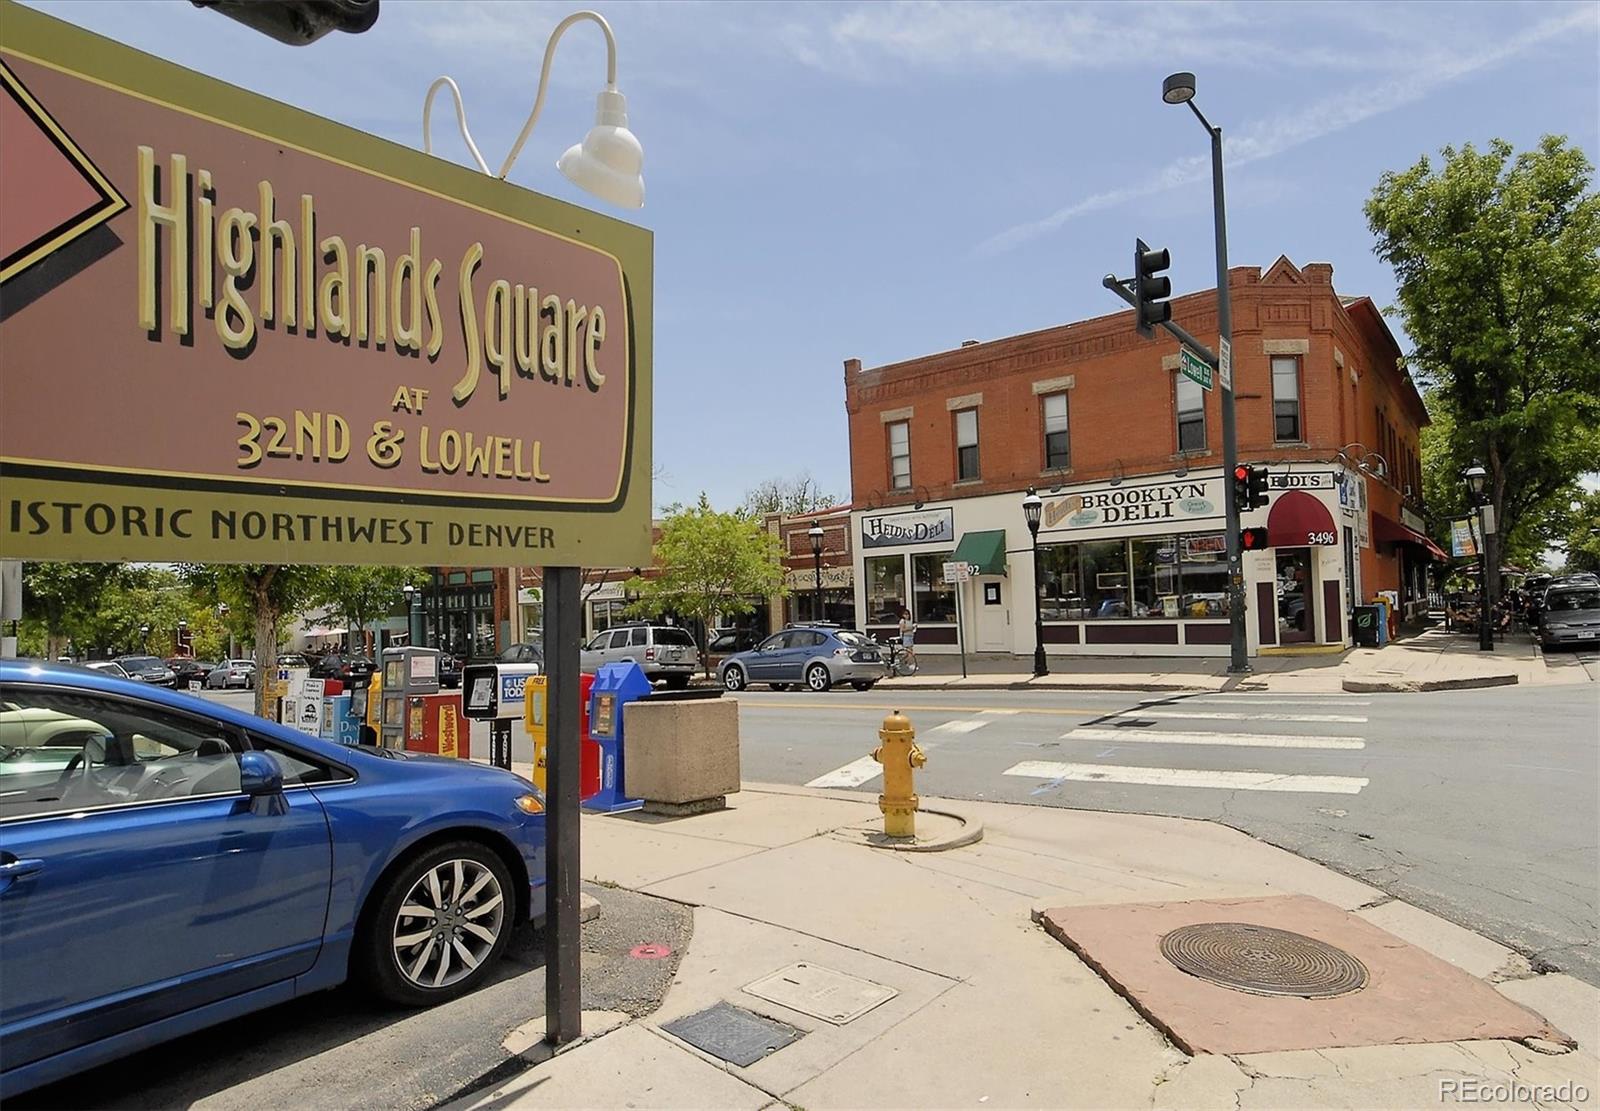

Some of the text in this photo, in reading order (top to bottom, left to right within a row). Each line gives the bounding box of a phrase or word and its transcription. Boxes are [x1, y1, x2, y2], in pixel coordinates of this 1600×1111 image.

[137, 145, 607, 402] Highlands Square
[391, 386, 431, 413] AT
[235, 410, 551, 481] 32ND & LOWELL
[1081, 483, 1207, 509] BROOKLYN
[10, 500, 557, 550] ISTORIC NORTHWEST DENVER
[1102, 501, 1174, 524] DELI
[914, 519, 945, 541] DELI
[1307, 531, 1334, 545] 3496
[532, 677, 546, 685] FREE
